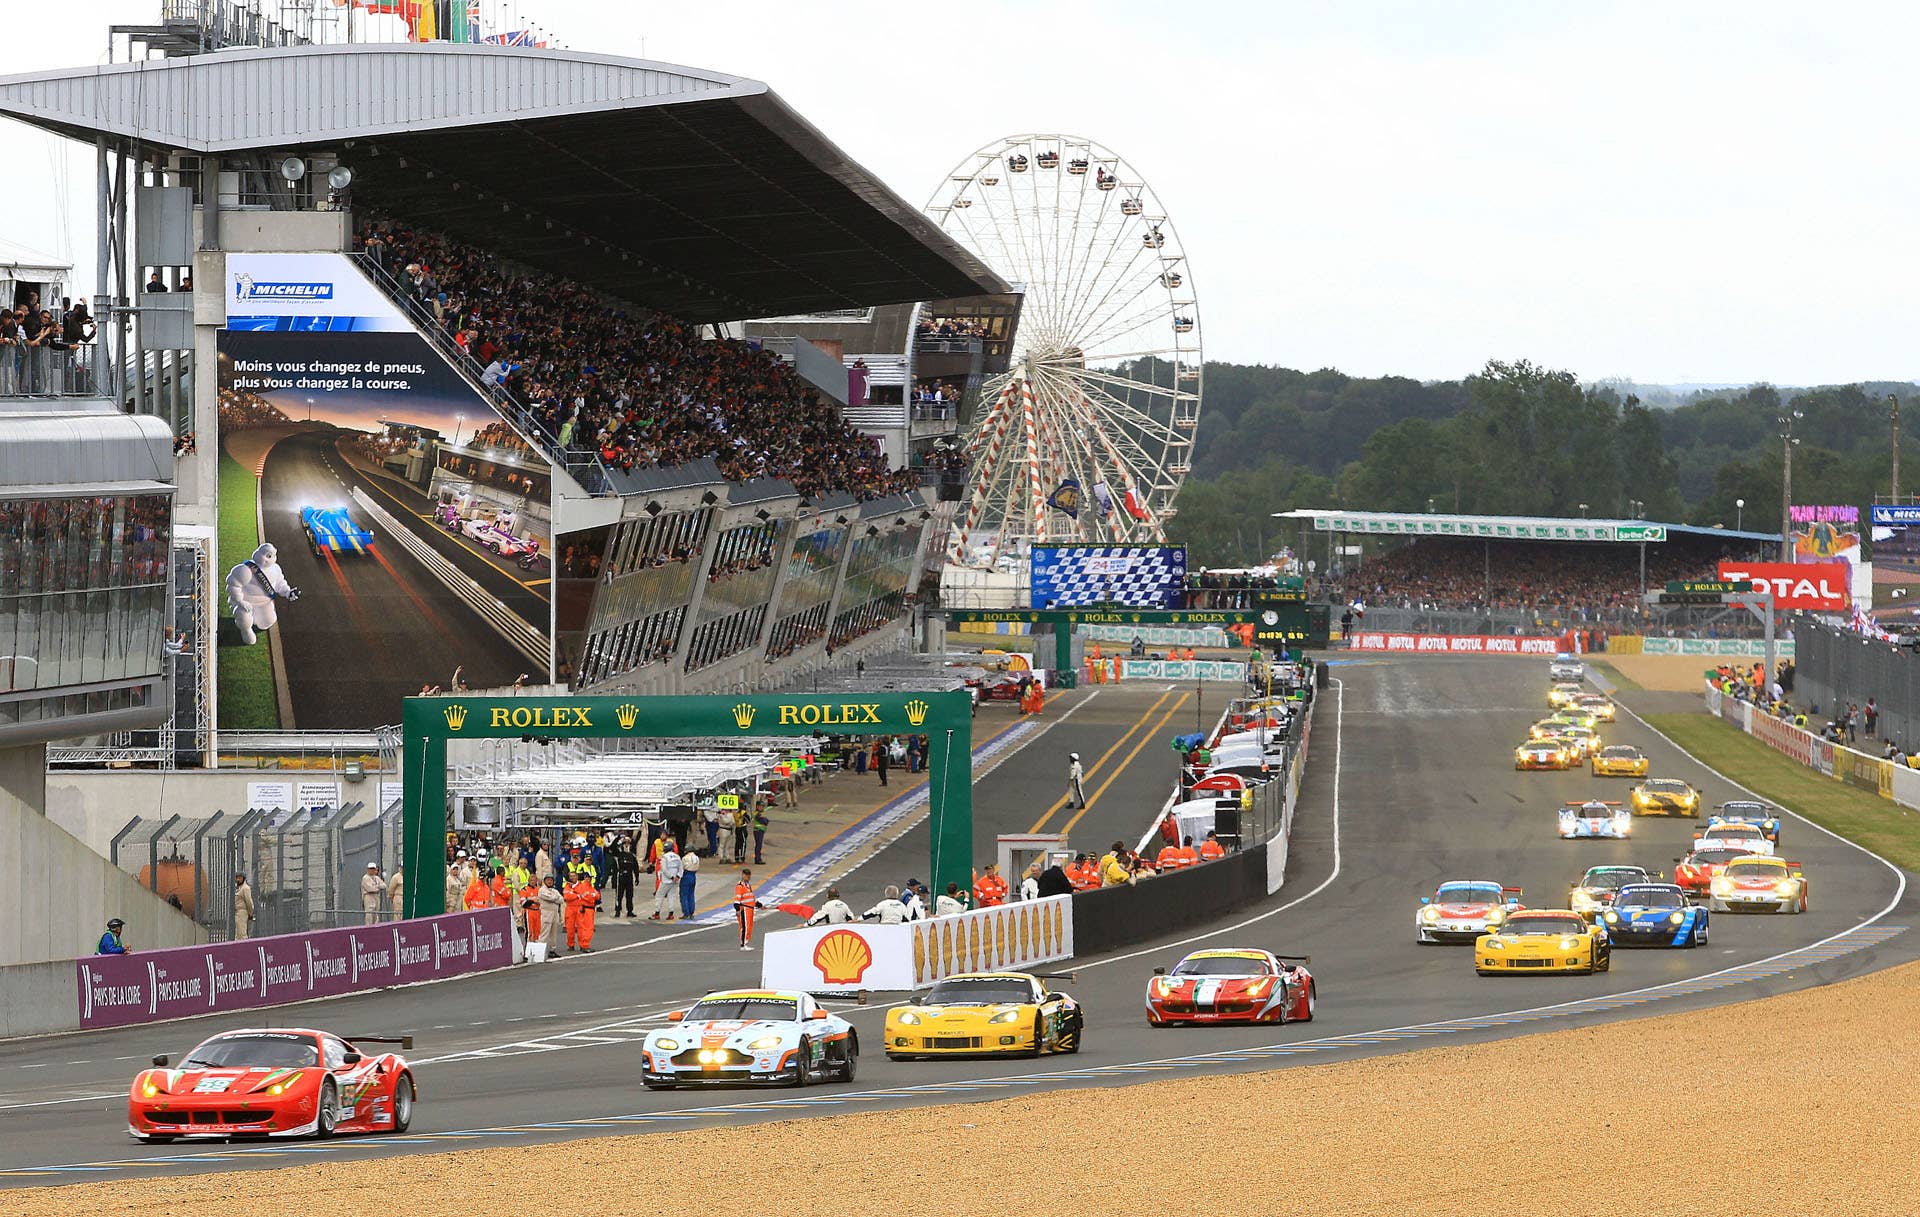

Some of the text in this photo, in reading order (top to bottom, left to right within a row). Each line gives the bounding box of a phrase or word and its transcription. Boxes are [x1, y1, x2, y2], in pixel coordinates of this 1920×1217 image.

[255, 286, 330, 294] MICHELIN
[234, 360, 426, 376] Moins vous changez de pneus,
[233, 376, 411, 391] plus vous changez la course.
[1618, 531, 1642, 539] Sarthe
[1092, 560, 1108, 570] 24
[1723, 572, 1841, 599] TOTAL
[983, 613, 1021, 621] ROLEX
[1084, 614, 1122, 622] ROLEX
[1188, 614, 1225, 622] ROLEX
[1418, 637, 1448, 650] MOTUL
[1451, 638, 1482, 650] MOTUL
[490, 707, 592, 728] ROLEX
[778, 704, 882, 725] ROLEX
[722, 796, 734, 806] 66
[630, 812, 642, 823] 43
[358, 950, 389, 972] PAYS DE LA LOIRE
[401, 944, 430, 965] PAYS DE LA LOIRE
[267, 963, 301, 985] PAYS DE LA LOIRE
[314, 957, 346, 979] PAYS DE LA LOIRE
[217, 970, 254, 993] PAYS DE LA LOIRE
[94, 985, 141, 1006] PAYS DE LA LOIRE
[159, 978, 201, 1002] PAYS DE LA LOIRE
